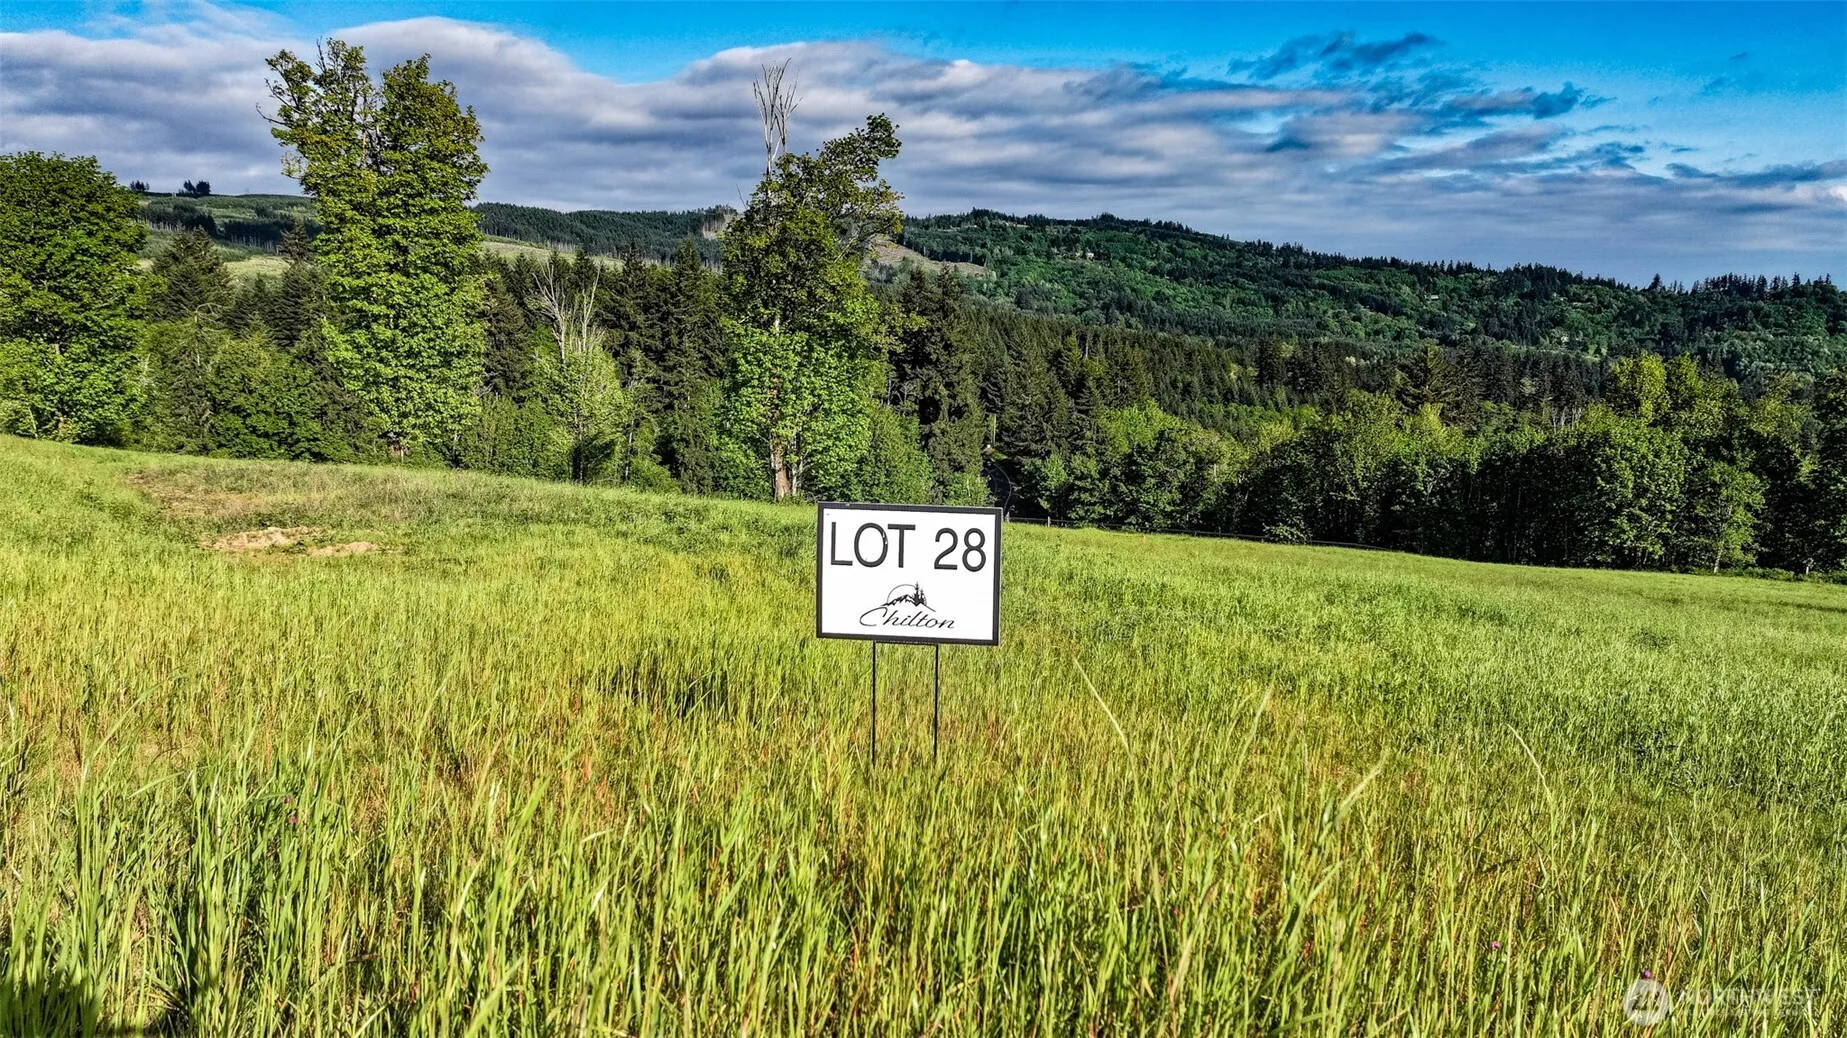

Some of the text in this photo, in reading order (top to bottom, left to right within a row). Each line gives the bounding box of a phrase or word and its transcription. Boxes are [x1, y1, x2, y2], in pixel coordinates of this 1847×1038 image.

[830, 521, 987, 573] LOT 28
[859, 606, 955, 629] Chilton
